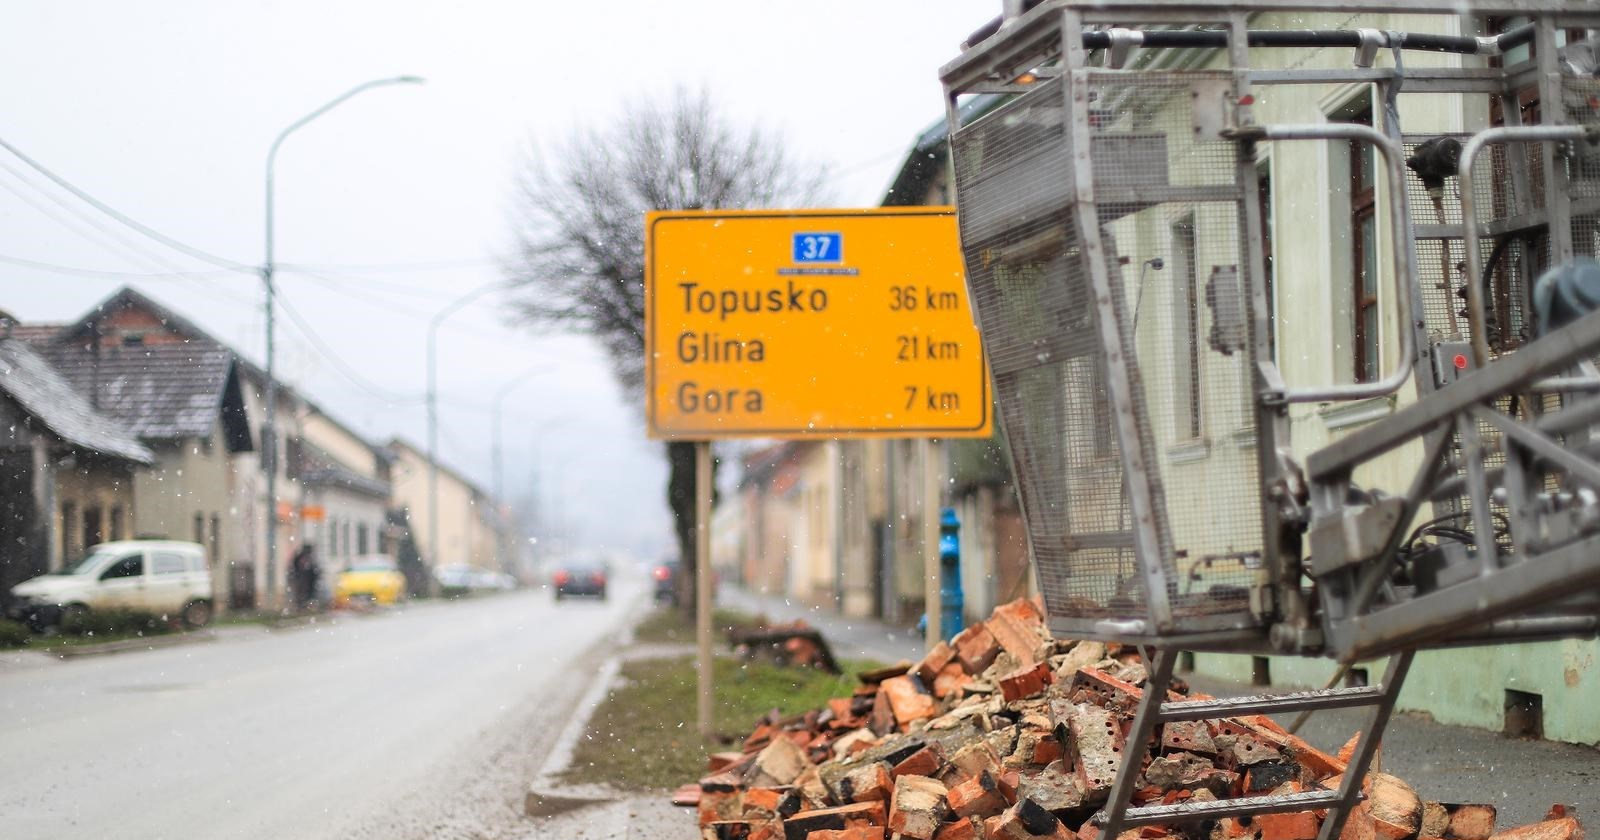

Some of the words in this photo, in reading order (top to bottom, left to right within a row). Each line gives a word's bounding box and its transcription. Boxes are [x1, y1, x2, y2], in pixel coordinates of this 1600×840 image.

[803, 236, 832, 259] 37
[679, 282, 828, 320] Topusko
[889, 286, 917, 311] 36
[926, 286, 959, 311] km
[678, 333, 765, 363] Glina
[897, 336, 918, 361] 21
[926, 336, 960, 361] km
[678, 382, 764, 413] Gora
[904, 386, 918, 411] 7
[926, 386, 960, 411] km
